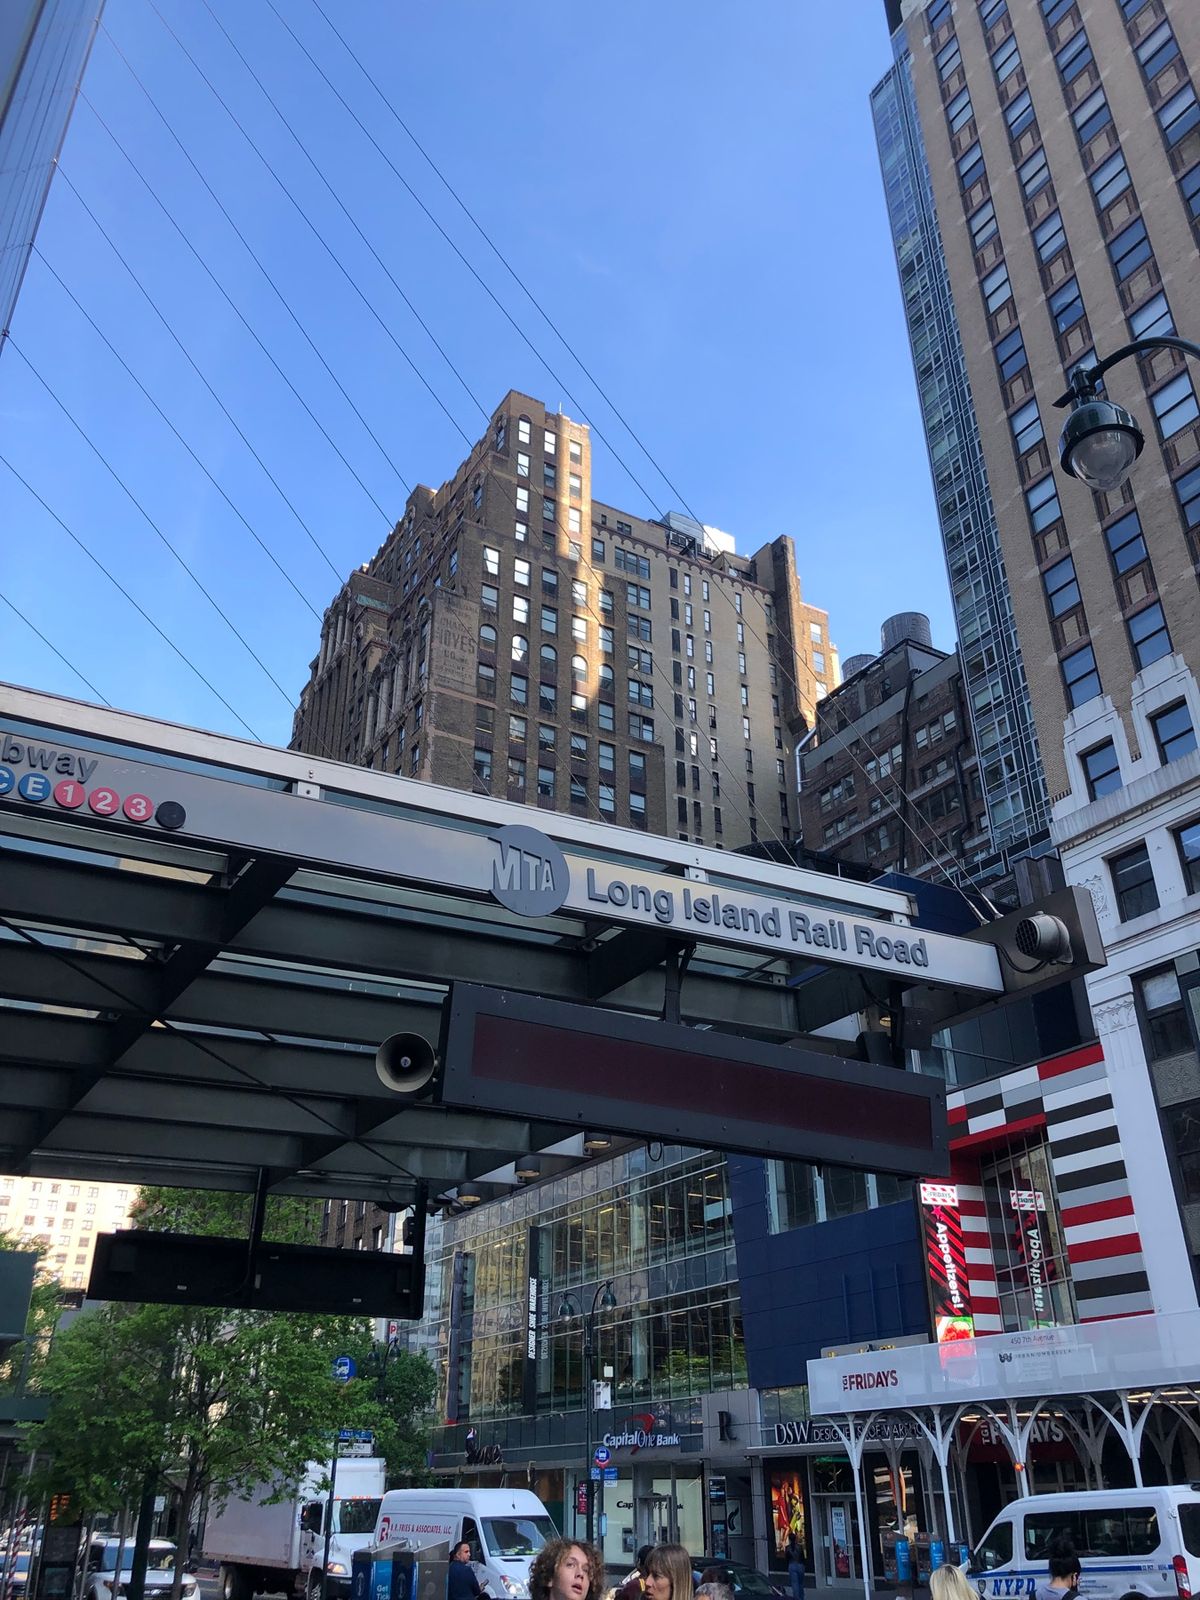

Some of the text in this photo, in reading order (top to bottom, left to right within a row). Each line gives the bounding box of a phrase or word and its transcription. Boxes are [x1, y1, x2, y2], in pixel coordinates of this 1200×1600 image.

[0, 735, 99, 784] bway
[26, 776, 46, 797] E
[95, 791, 113, 811] 2
[129, 797, 147, 817] 3
[490, 838, 556, 891] MTA
[586, 867, 928, 968] Long Island Rail Road
[935, 1222, 965, 1309] Appetizers!
[528, 1312, 537, 1330] SHOE
[528, 1330, 537, 1359] DESIGNER
[848, 1369, 899, 1391] FRIDAYS
[656, 1433, 680, 1446] Bank
[774, 1420, 811, 1445] DSW
[992, 1578, 1037, 1596] NYPD
